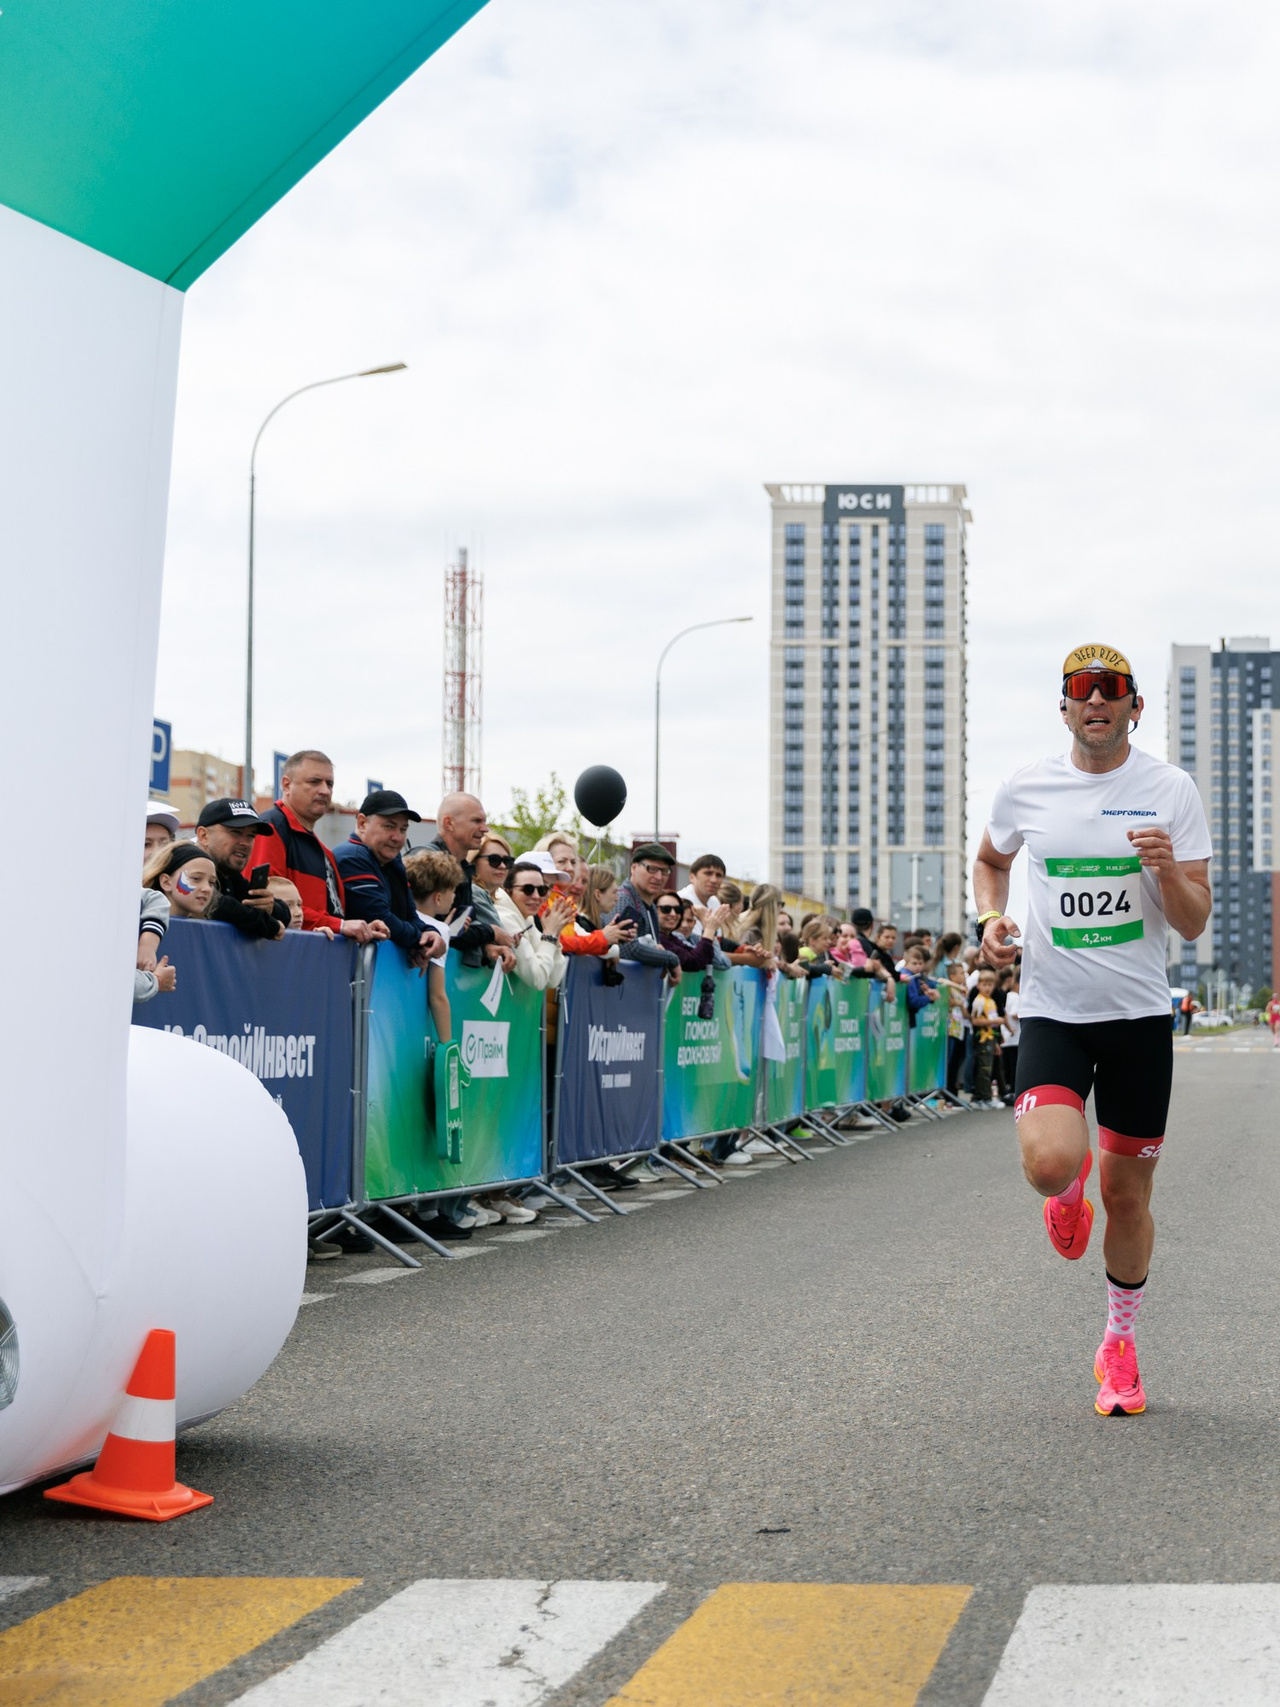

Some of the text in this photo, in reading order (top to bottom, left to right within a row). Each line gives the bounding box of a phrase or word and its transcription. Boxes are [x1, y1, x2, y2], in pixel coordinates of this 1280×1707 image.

[838, 493, 892, 510] ЮСИ
[1074, 647, 1125, 667] BEER RIDE
[1100, 809, 1157, 817] ЭНЕРГОМЕРА
[1060, 890, 1131, 917] 0024
[477, 1036, 504, 1064] Прайм
[1014, 1092, 1037, 1123] sh
